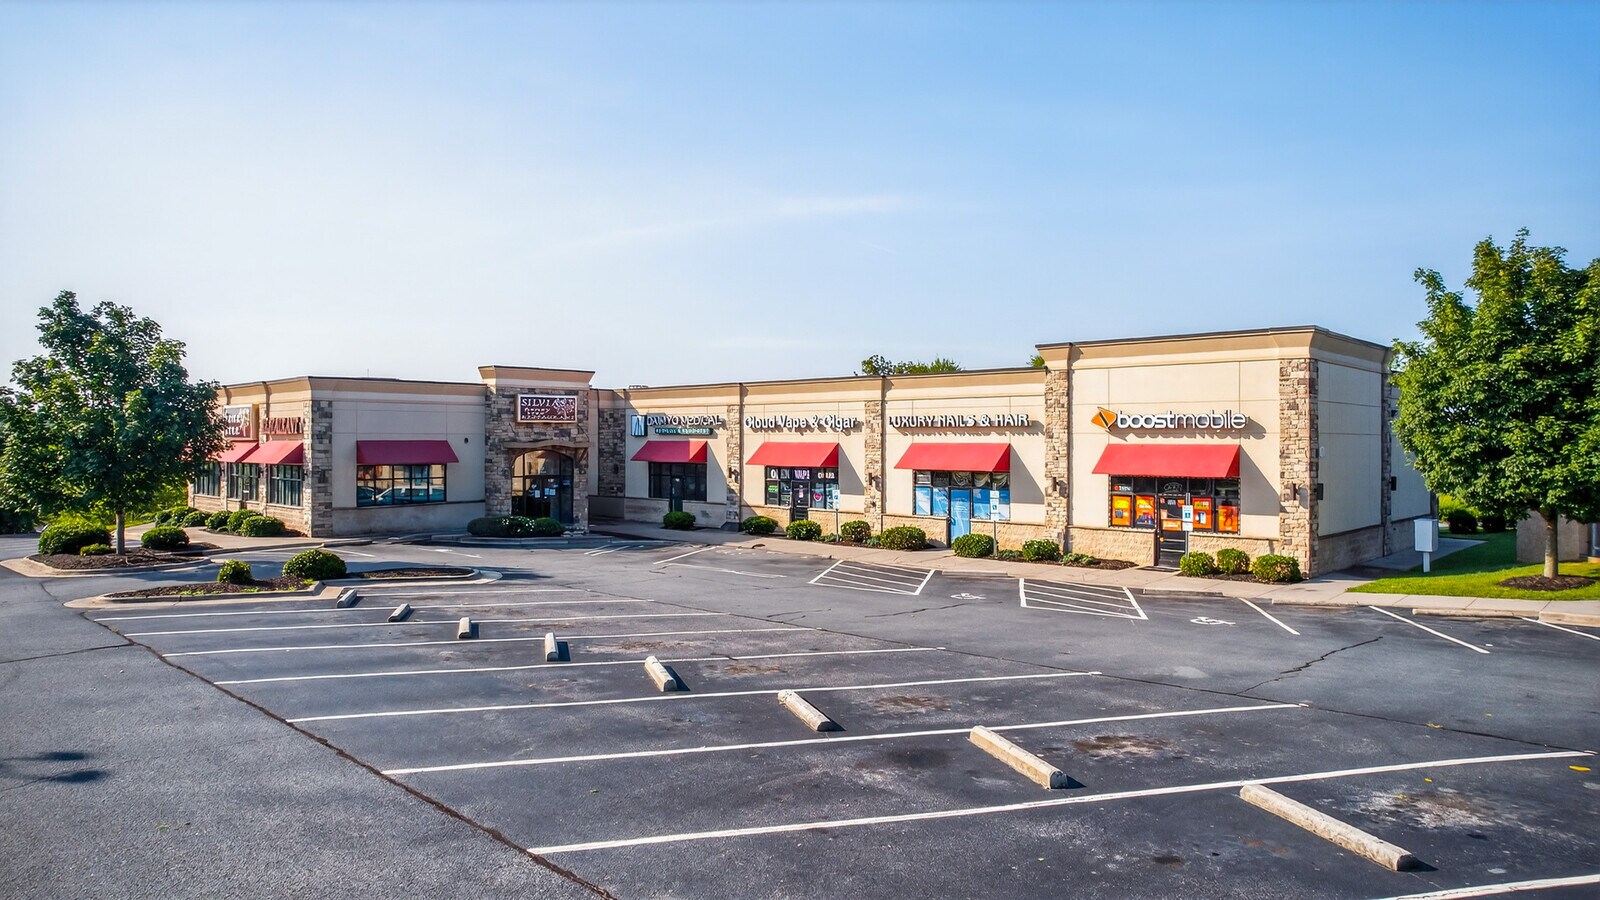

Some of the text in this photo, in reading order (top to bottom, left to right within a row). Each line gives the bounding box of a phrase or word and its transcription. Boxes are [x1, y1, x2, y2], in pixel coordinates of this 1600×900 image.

[745, 415, 857, 431] Cloud Vape & Cigar
[889, 413, 1030, 428] LUXURY NAILS & HAIR
